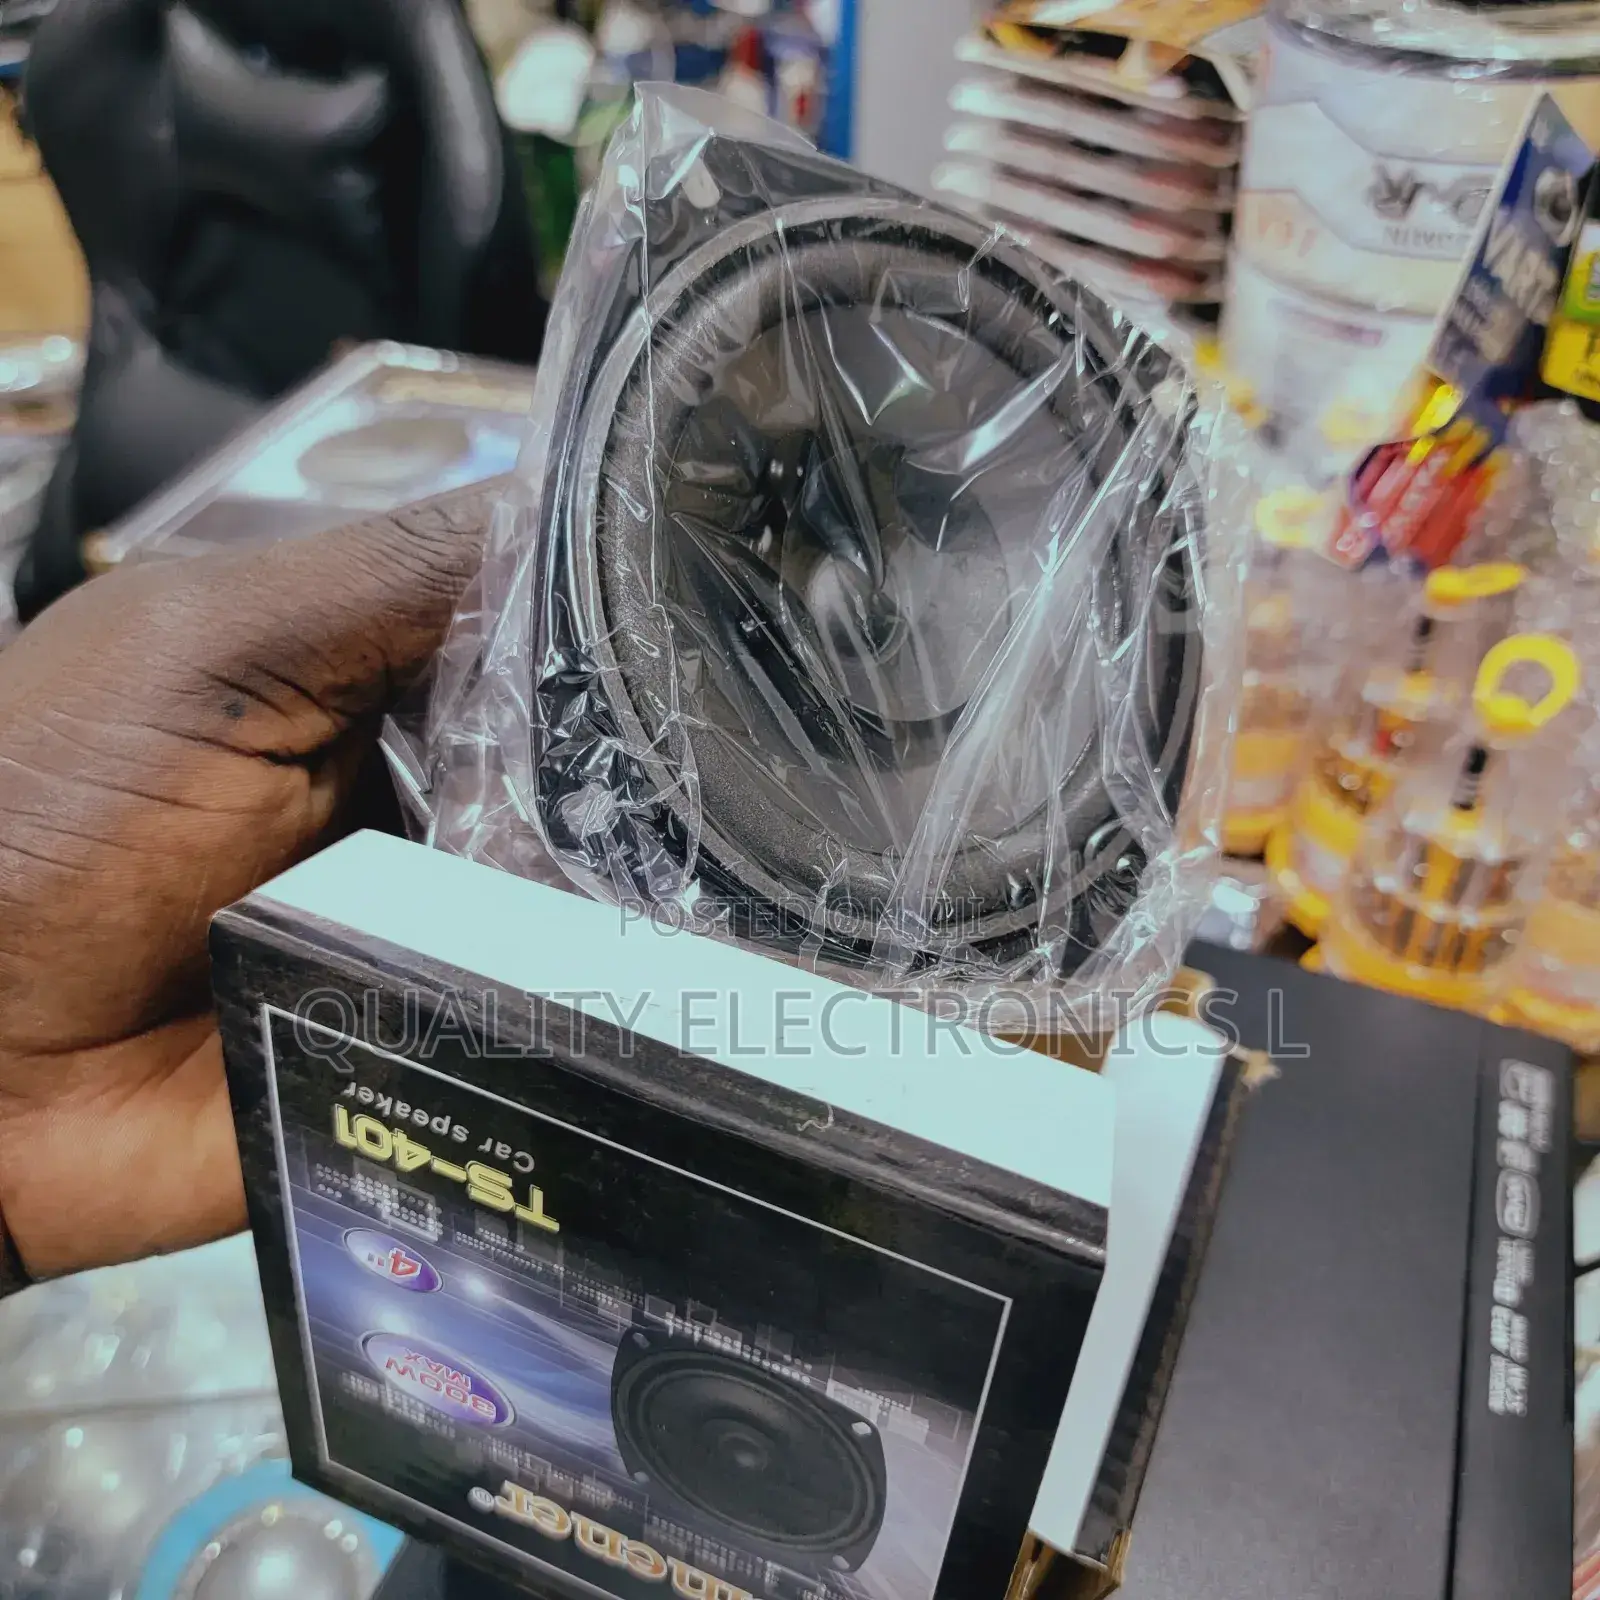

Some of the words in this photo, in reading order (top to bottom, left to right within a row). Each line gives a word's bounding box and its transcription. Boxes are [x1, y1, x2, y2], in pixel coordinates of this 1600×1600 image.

[343, 1081, 471, 1142] speaker
[332, 1103, 560, 1233] TS-401
[478, 1134, 536, 1173] Car
[404, 1348, 472, 1391] MAX
